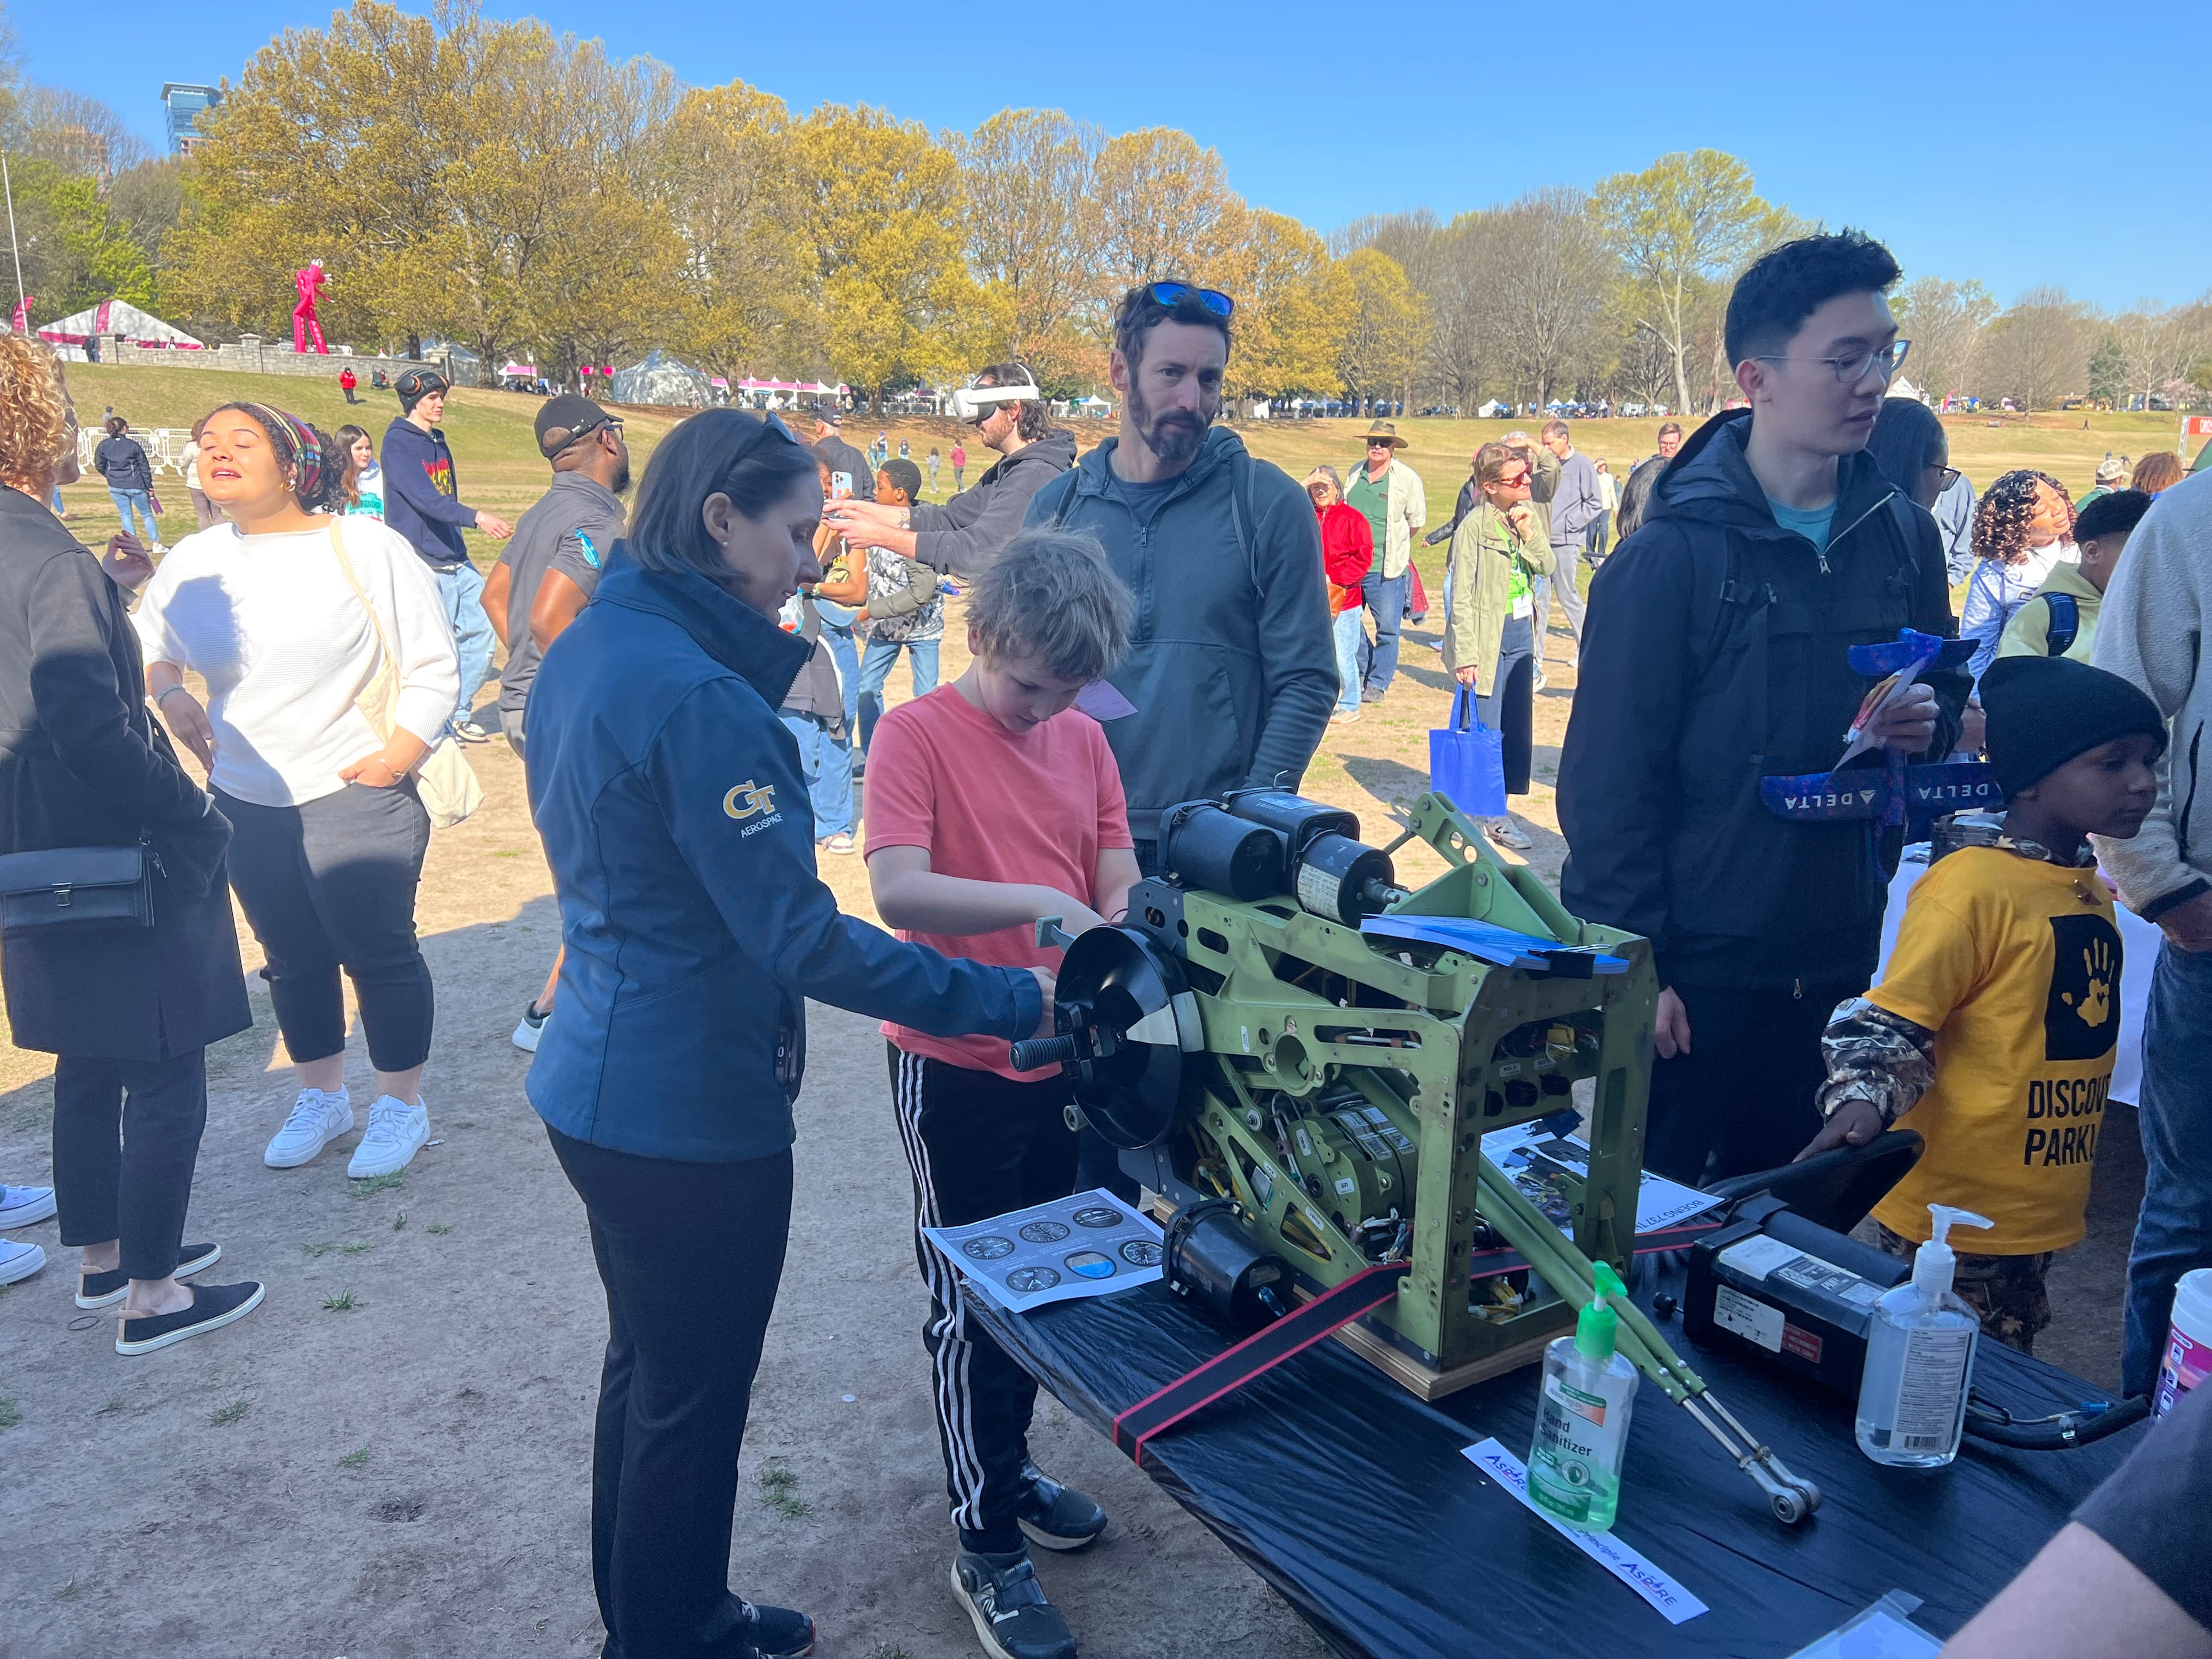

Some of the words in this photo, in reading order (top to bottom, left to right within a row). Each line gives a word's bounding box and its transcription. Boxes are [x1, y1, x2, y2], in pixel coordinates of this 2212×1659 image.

[1918, 783, 1988, 800] DELTA
[1785, 792, 1853, 810] DELTA
[741, 813, 783, 838] AEROSPACE
[1663, 1200, 1705, 1218] BOEING
[1646, 1215, 1668, 1226] 737
[1543, 1407, 1570, 1433] Hand
[1540, 1422, 1593, 1457] Sanitizer
